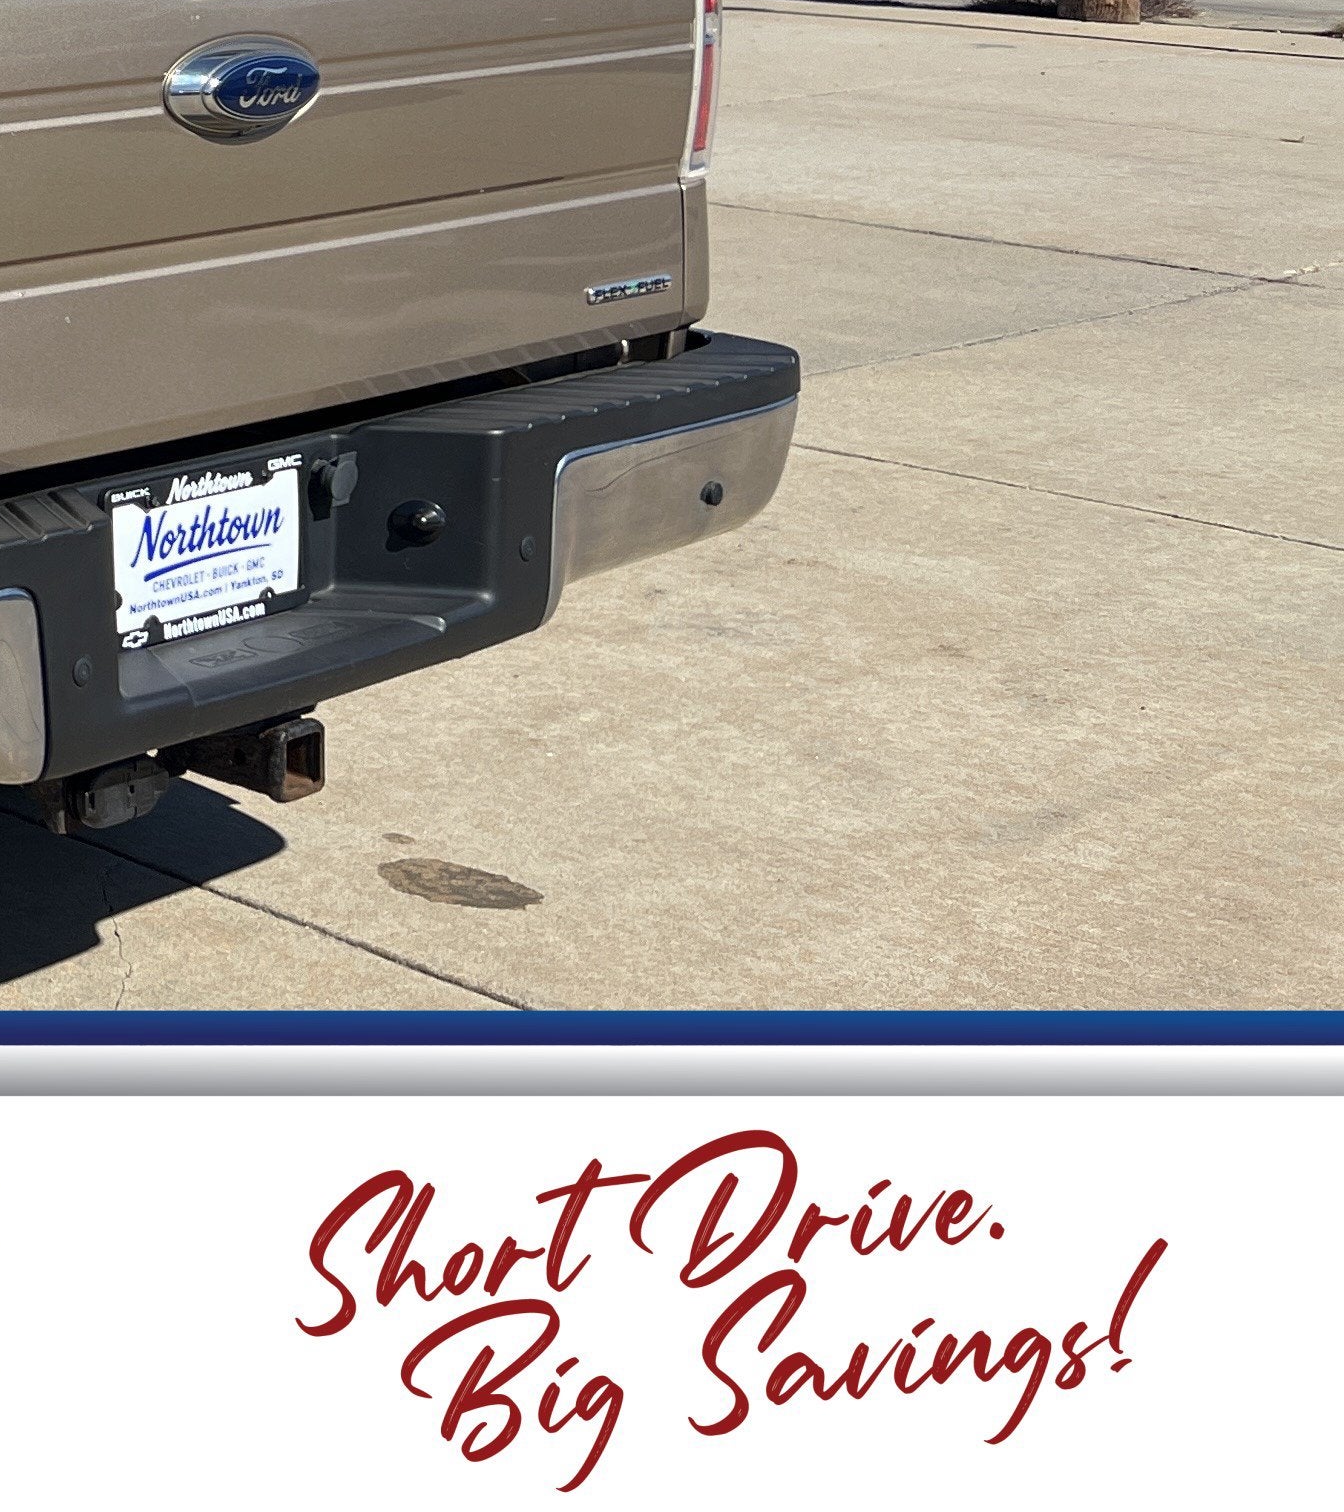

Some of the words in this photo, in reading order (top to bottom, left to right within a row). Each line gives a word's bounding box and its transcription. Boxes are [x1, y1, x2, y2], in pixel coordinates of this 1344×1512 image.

[238, 66, 304, 109] Ford
[267, 454, 302, 471] GMC
[111, 487, 150, 503] BUICK
[166, 471, 254, 505] Northtown
[130, 504, 285, 568] Northtown
[129, 586, 223, 615] NorthtownUSA.com
[230, 575, 269, 591] Yankton,
[271, 569, 284, 581] SD
[152, 570, 205, 593] CHEVROLET
[212, 563, 239, 579] BUICK
[246, 556, 266, 571] GMC
[163, 602, 266, 640] NorthtownUSA.com
